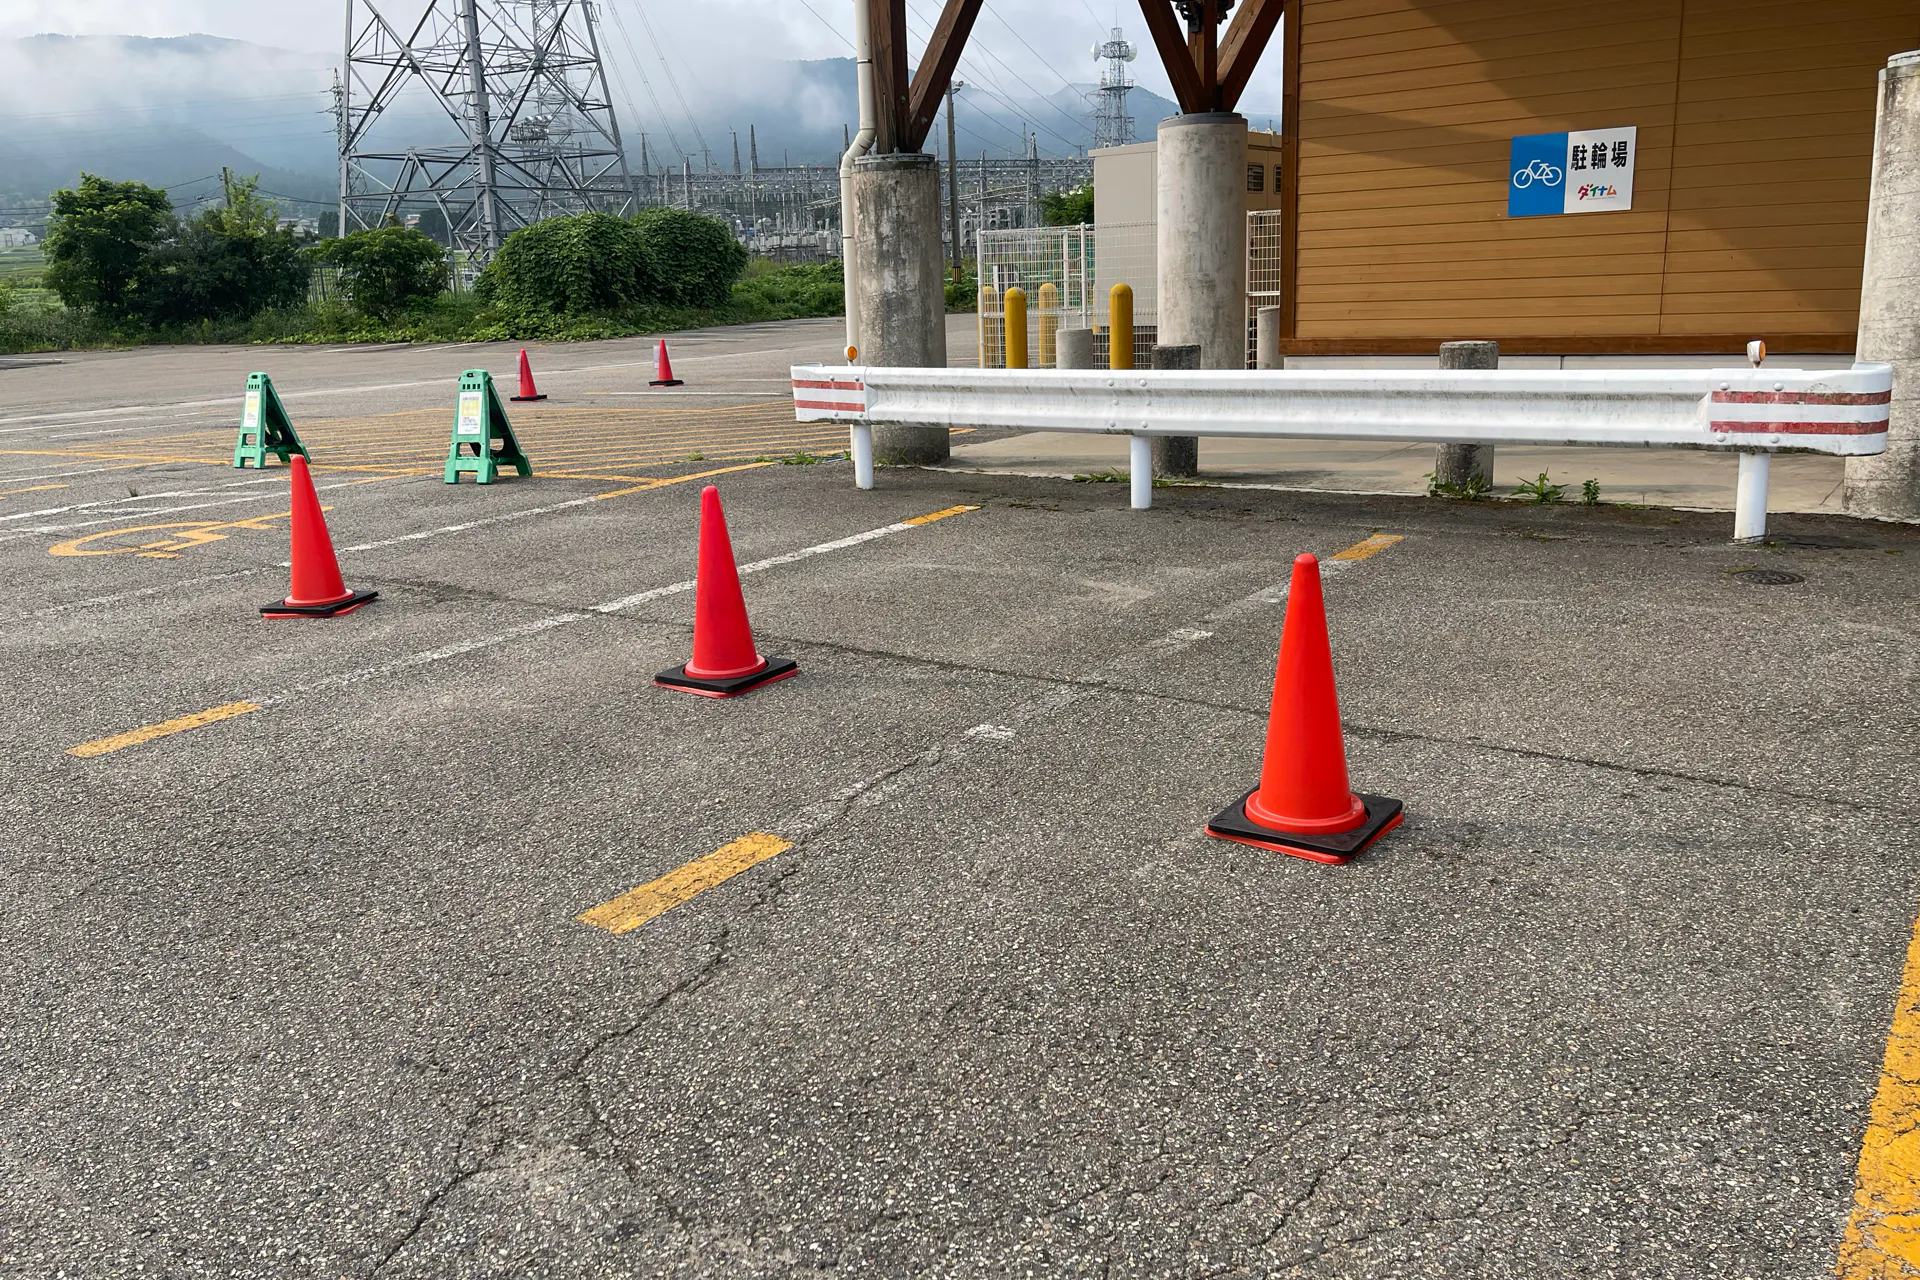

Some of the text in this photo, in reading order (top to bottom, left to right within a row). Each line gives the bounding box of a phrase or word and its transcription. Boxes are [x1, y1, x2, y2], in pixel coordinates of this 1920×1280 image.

[1571, 141, 1628, 171] 駐輪場
[1577, 183, 1617, 200] ダイナム
